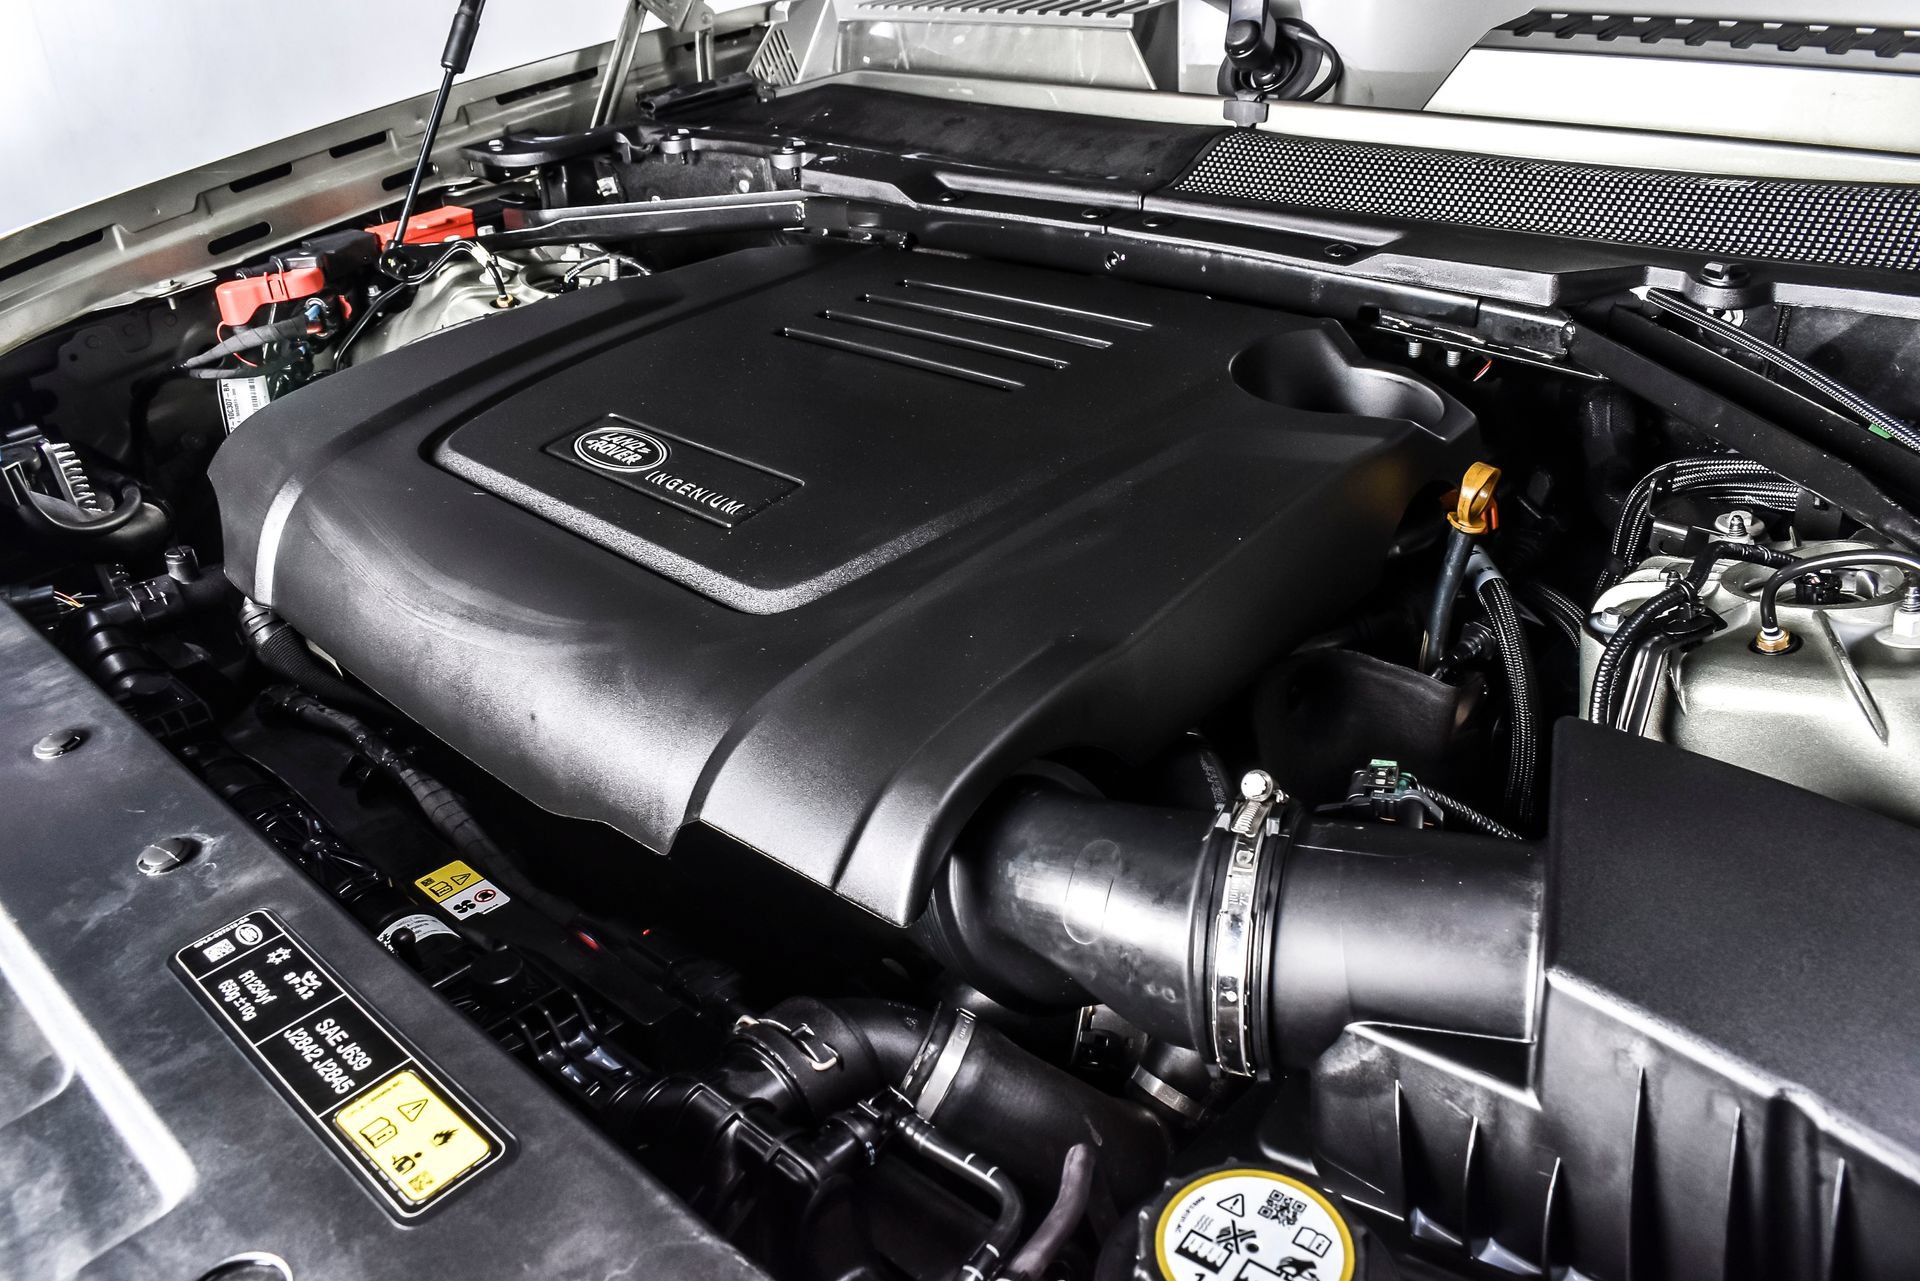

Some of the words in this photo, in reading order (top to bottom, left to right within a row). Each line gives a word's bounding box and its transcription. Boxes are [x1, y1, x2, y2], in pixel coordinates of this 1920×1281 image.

[587, 440, 642, 466] ROVER
[600, 432, 647, 451] LAND
[645, 470, 745, 515] INGENIUM
[238, 969, 278, 1005] R1234yf
[283, 1027, 325, 1063] J2842
[312, 1058, 356, 1094] J2845
[315, 1018, 349, 1047] SAE
[336, 1042, 372, 1071] J639
